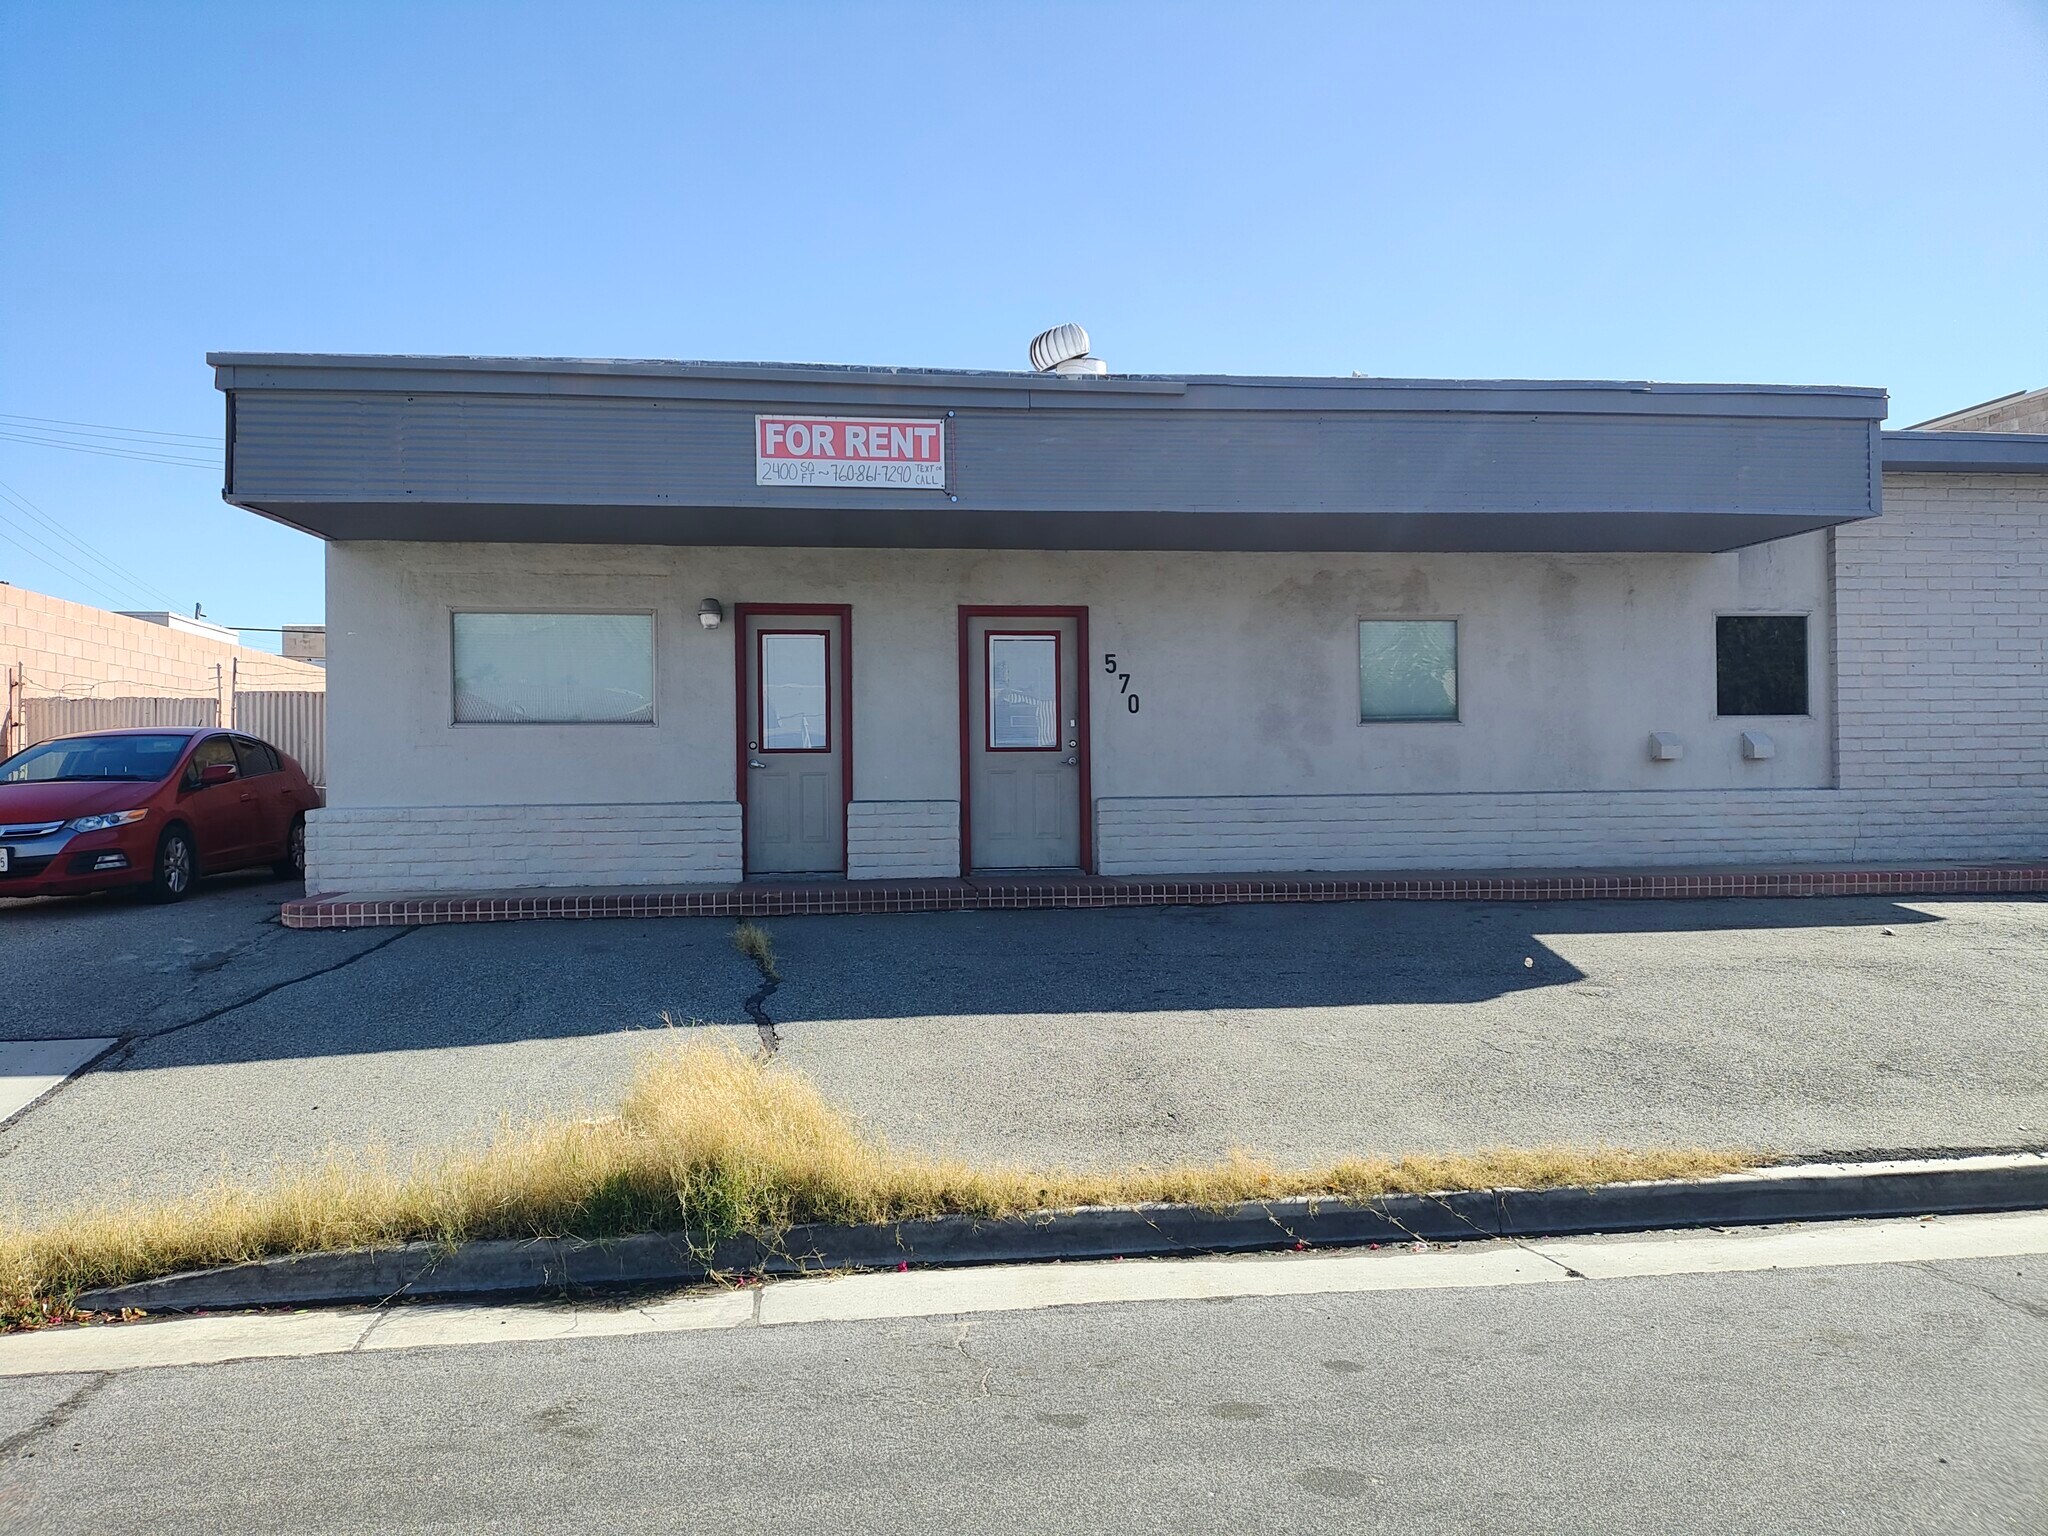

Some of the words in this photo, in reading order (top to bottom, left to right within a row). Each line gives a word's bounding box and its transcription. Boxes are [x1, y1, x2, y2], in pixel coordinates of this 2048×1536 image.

[765, 423, 835, 457] FOR
[845, 425, 936, 459] RENT
[762, 462, 798, 481] 2400
[800, 461, 815, 472] SQ
[830, 464, 912, 483] 760-861-7290
[915, 463, 934, 473] TEXT
[801, 473, 815, 484] FT
[915, 474, 939, 485] CALL
[1105, 653, 1139, 714] 570
